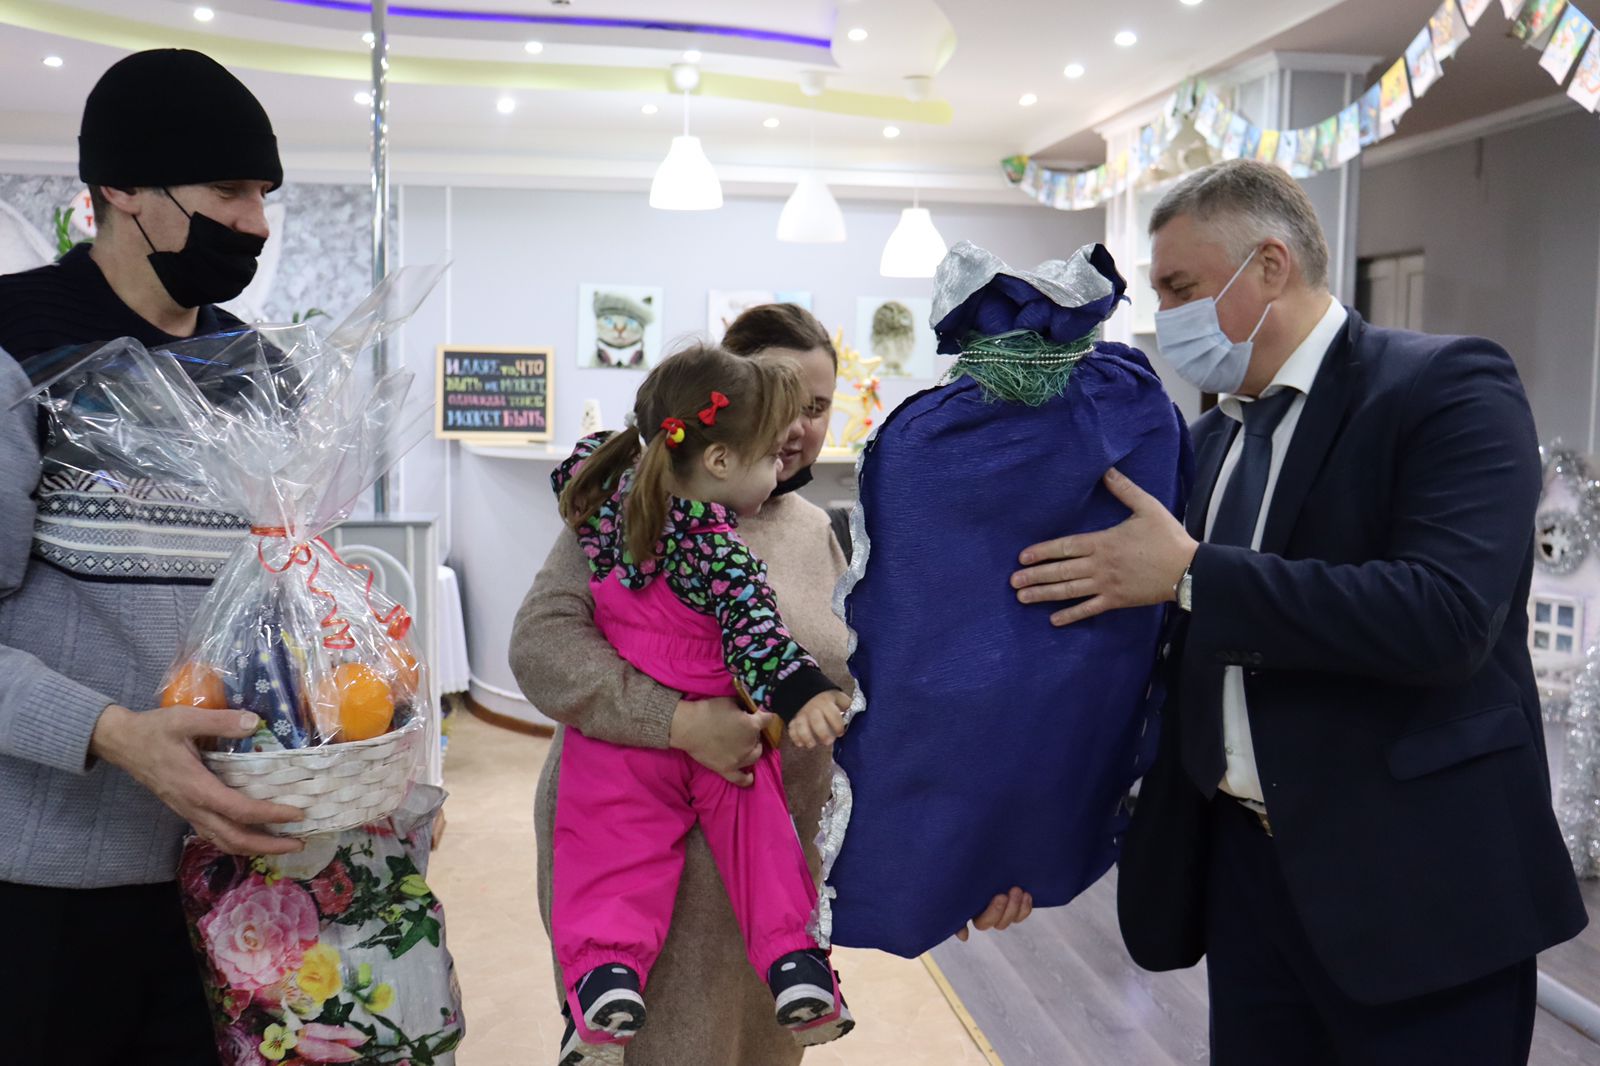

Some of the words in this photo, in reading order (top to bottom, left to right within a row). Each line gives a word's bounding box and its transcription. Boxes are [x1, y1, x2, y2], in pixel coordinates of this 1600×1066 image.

[446, 358, 459, 375] И
[515, 359, 545, 376] ЧТО
[447, 410, 501, 427] МОЖЕТ
[503, 410, 545, 427] БЫТЬ
